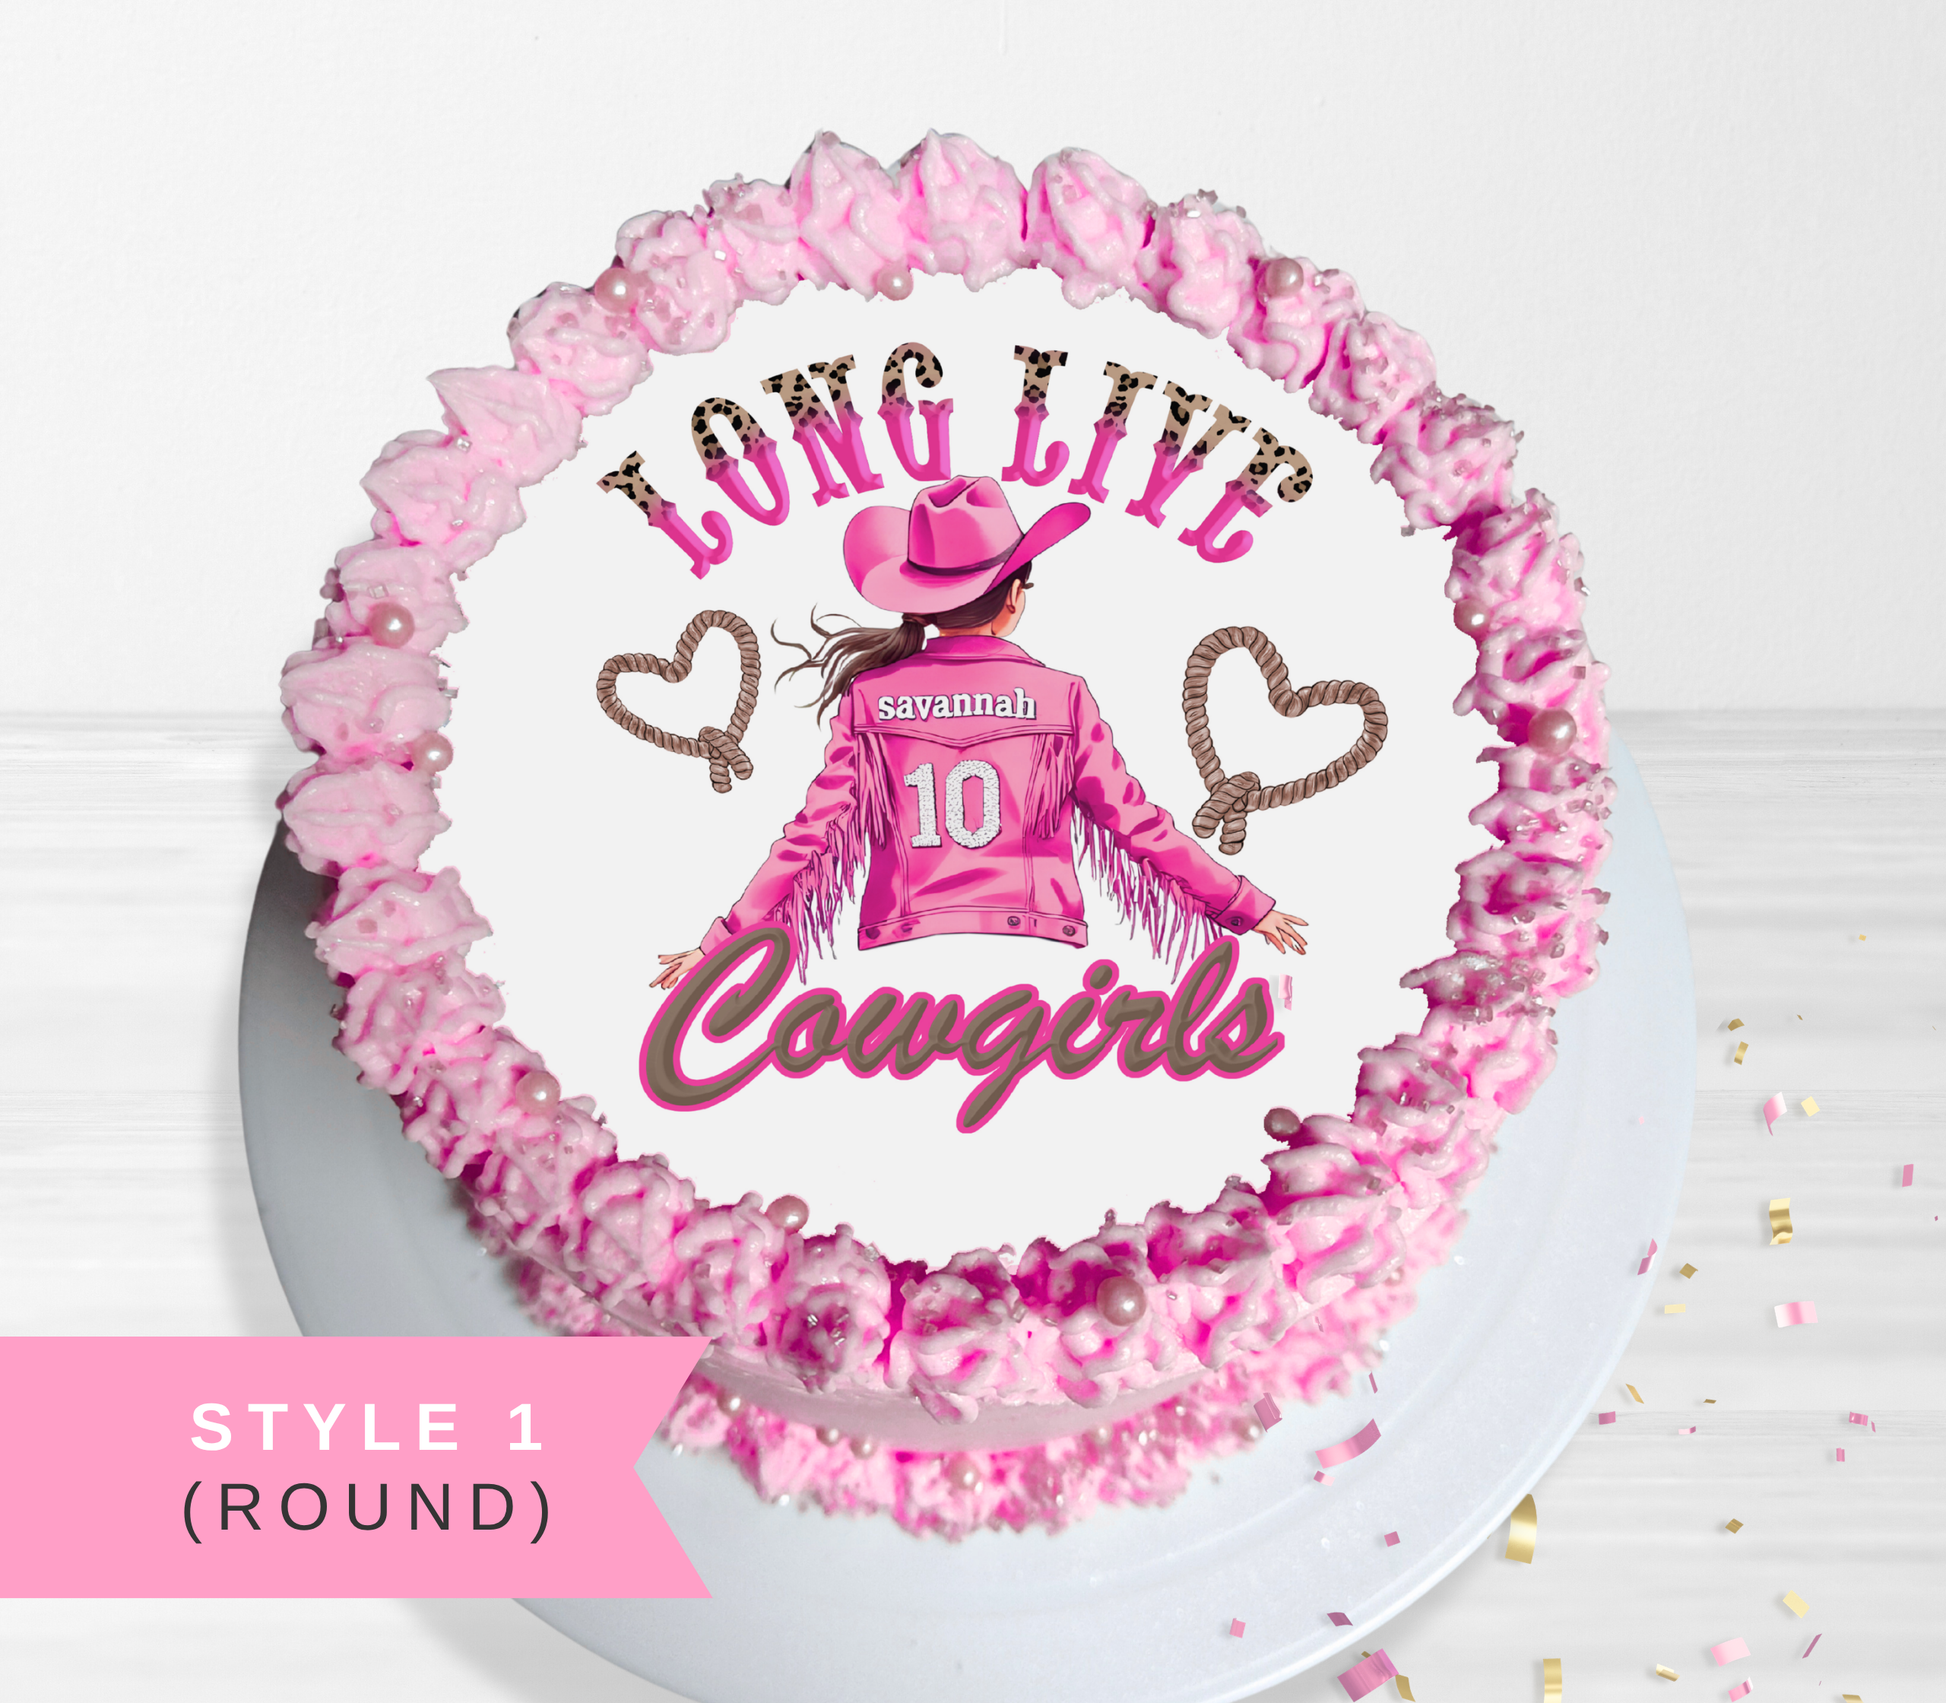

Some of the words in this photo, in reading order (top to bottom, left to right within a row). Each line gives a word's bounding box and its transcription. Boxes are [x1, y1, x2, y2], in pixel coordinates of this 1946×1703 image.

[597, 342, 953, 580] LONG
[1002, 345, 1313, 563] LIVE
[878, 687, 1037, 722] savannah
[904, 760, 1002, 849] 10
[639, 921, 1285, 1133] Cowgirls
